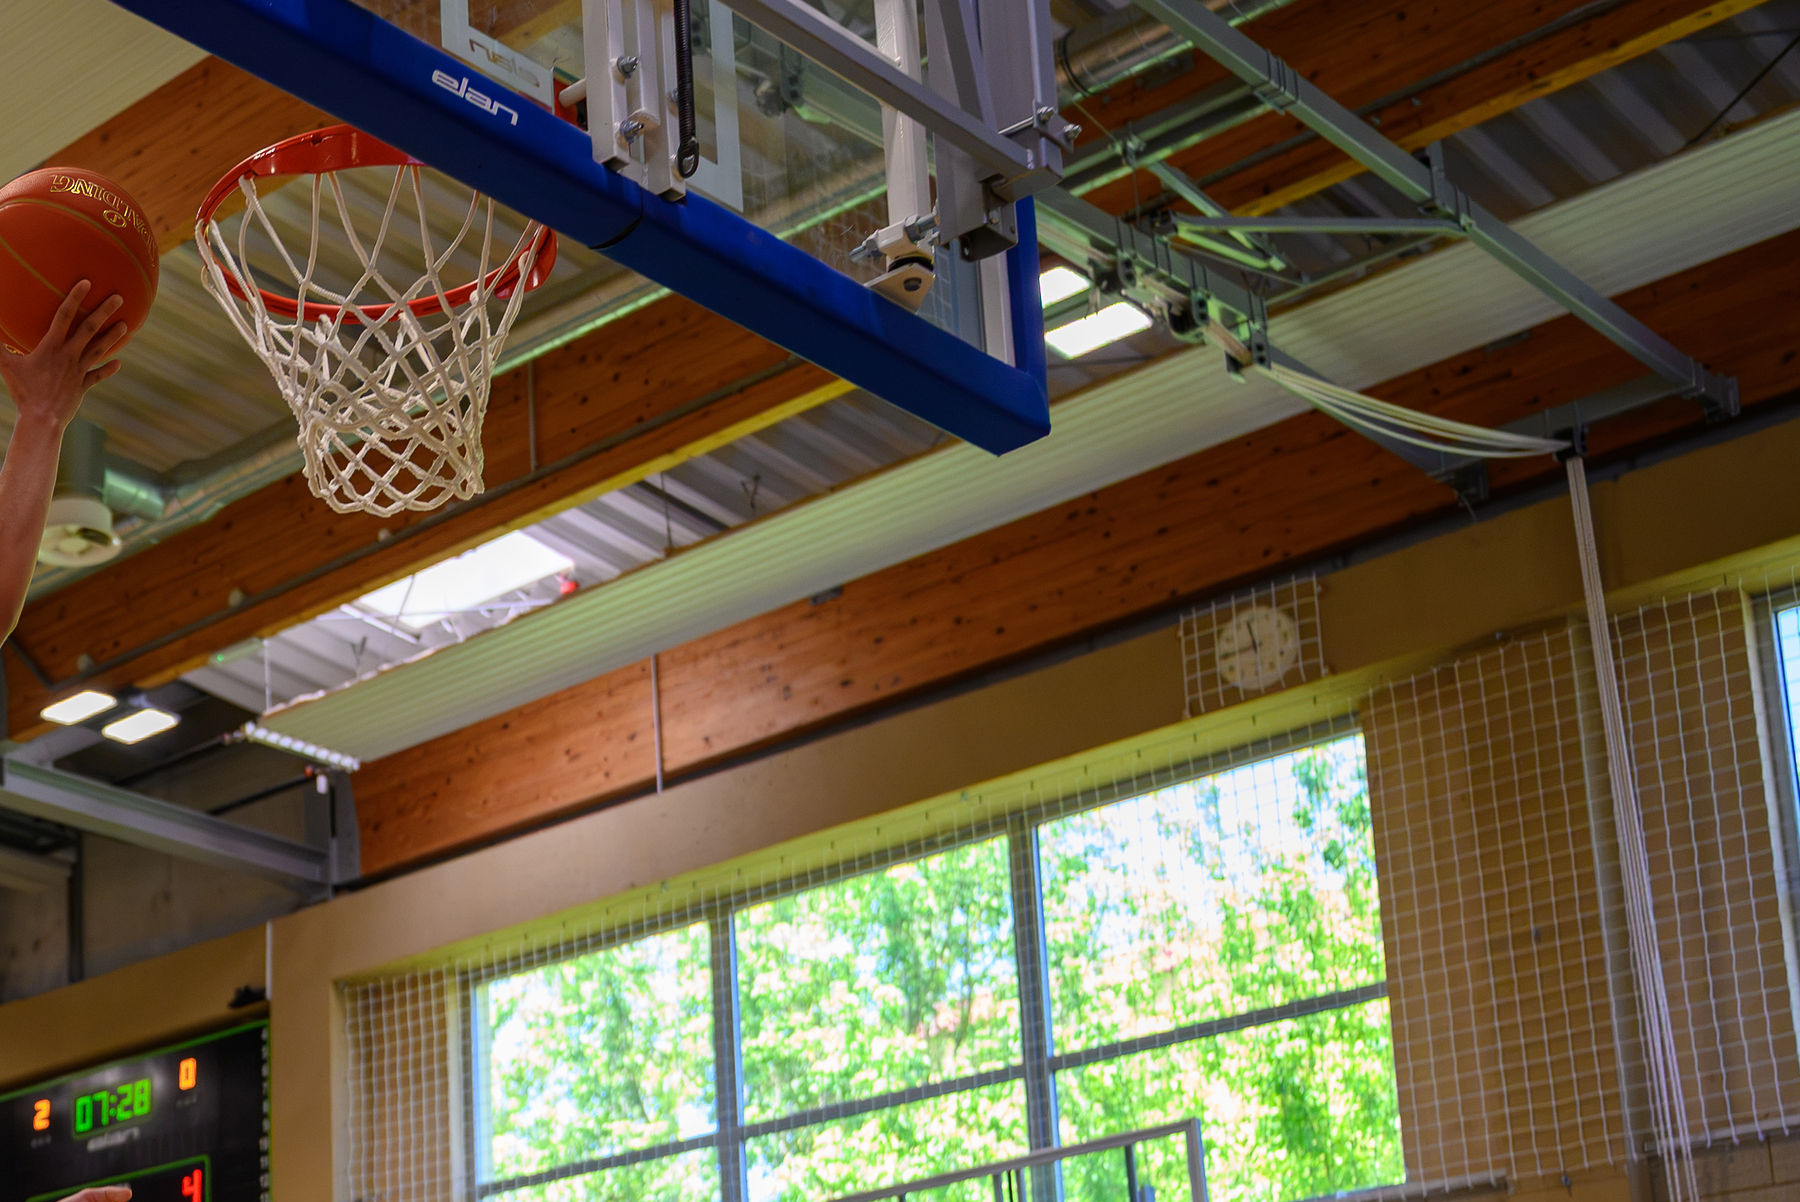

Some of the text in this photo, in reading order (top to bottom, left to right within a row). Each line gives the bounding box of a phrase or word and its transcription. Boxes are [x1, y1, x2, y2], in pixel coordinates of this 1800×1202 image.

[431, 69, 519, 126] elan
[178, 1057, 198, 1091] 0
[32, 1099, 51, 1131] 2
[75, 1078, 152, 1134] 07:28
